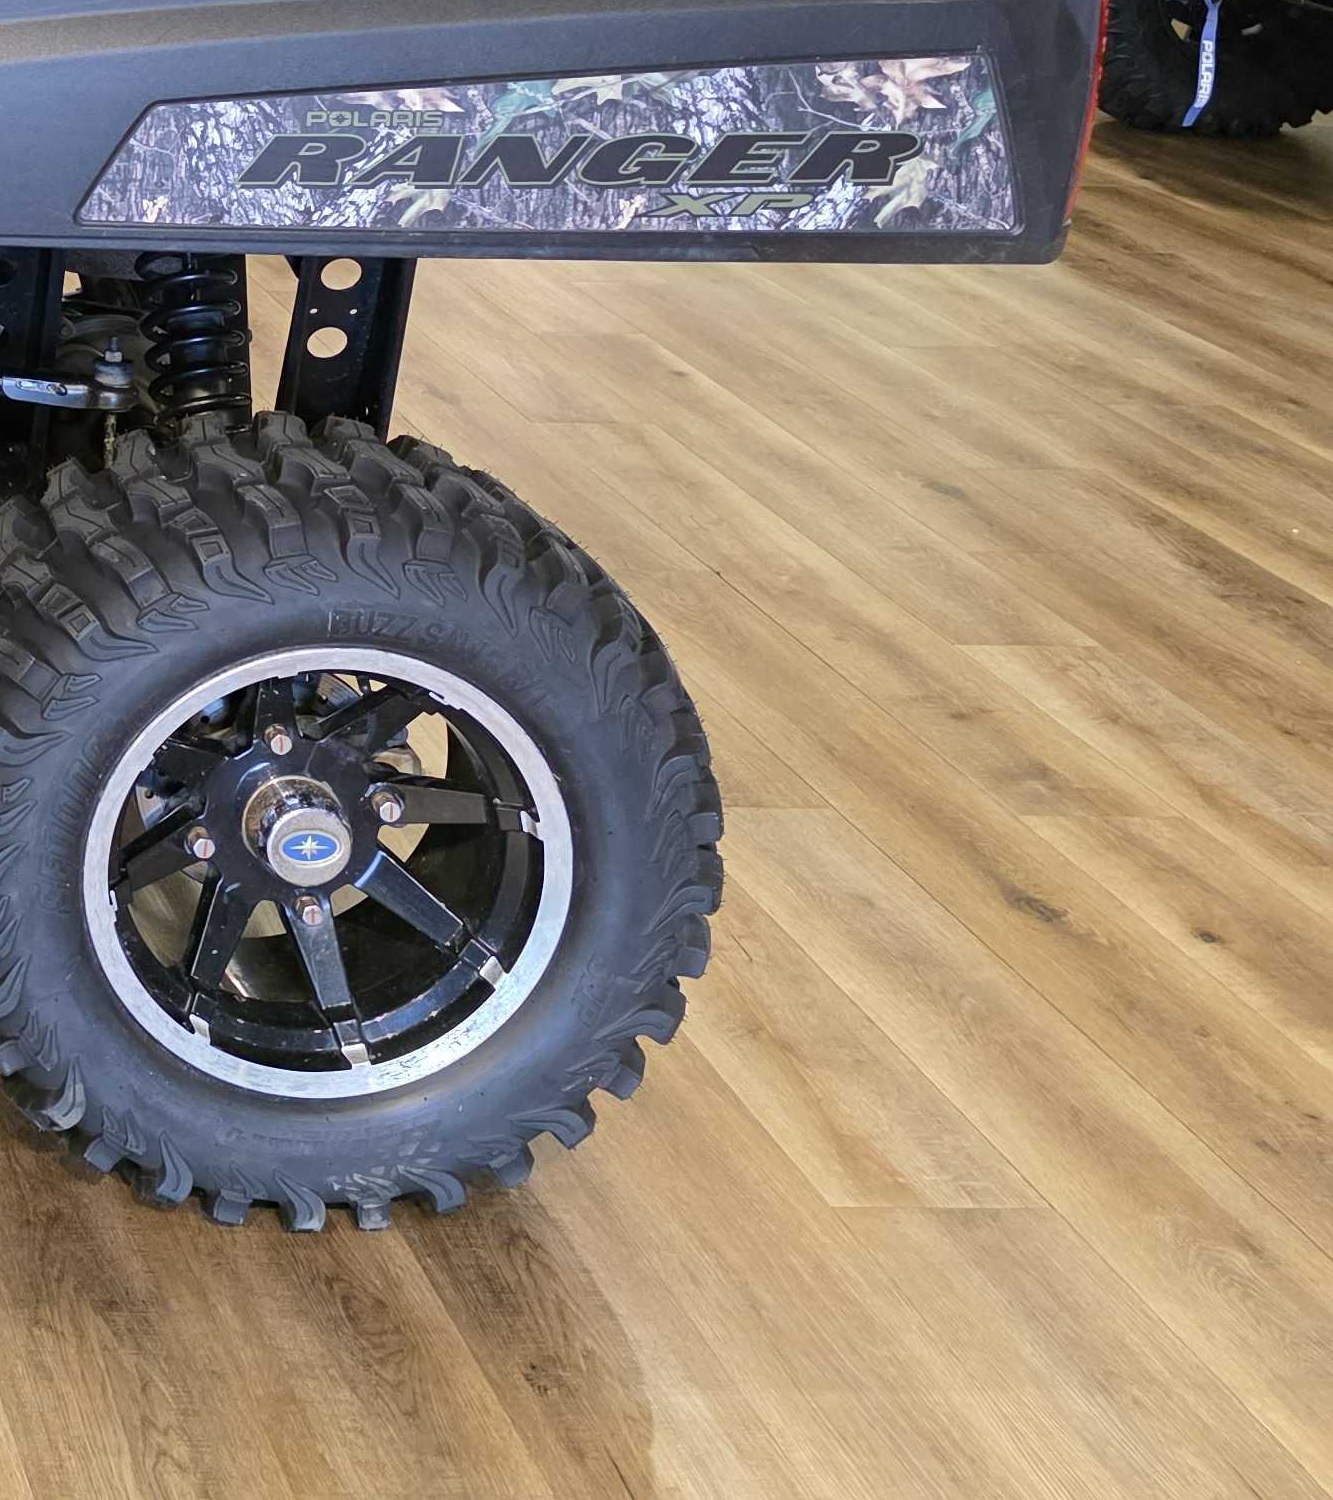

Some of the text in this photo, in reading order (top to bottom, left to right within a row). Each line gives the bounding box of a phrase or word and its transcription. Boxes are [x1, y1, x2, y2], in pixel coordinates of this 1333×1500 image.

[305, 110, 444, 128] POLARIS
[234, 132, 923, 189] RANGER
[636, 191, 816, 217] XP
